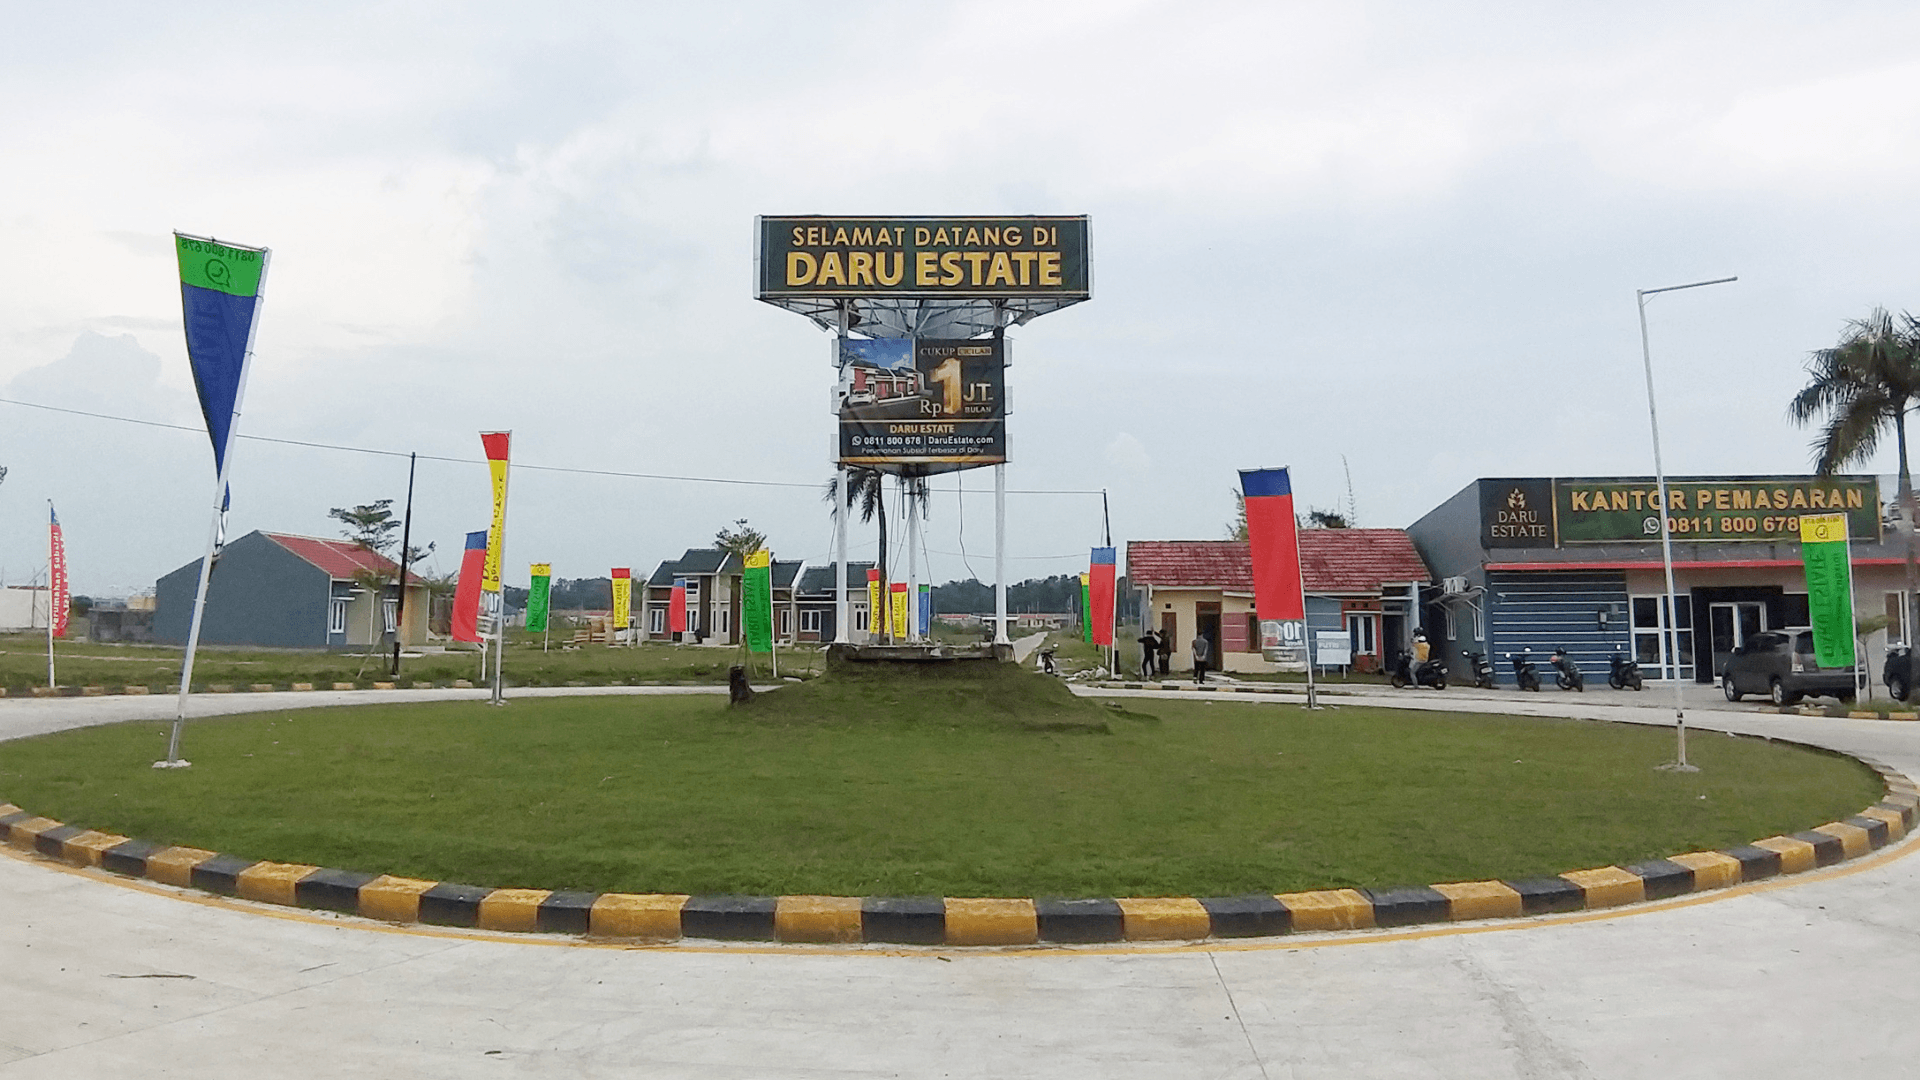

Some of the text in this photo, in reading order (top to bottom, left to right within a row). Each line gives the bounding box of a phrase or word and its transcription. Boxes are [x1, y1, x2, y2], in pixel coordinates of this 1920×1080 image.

[792, 226, 1056, 246] SELAMAT DATANG DI
[786, 251, 1062, 286] DARU ESTATE
[920, 347, 956, 356] CUKUP
[930, 357, 962, 414] 1
[920, 399, 942, 417] Rp
[889, 424, 955, 434] DARU ESTATE
[863, 435, 994, 446] 0811 800 678 DaruEstate.com
[959, 446, 966, 454] di
[967, 446, 984, 454] Daru
[1571, 488, 1863, 511] KANTOR PEMASARAN
[1498, 510, 1538, 523] DARU
[1491, 525, 1547, 537] ESTATE
[1668, 517, 1713, 533] 0811
[1721, 517, 1757, 533] 800
[1763, 516, 1799, 532] 678
